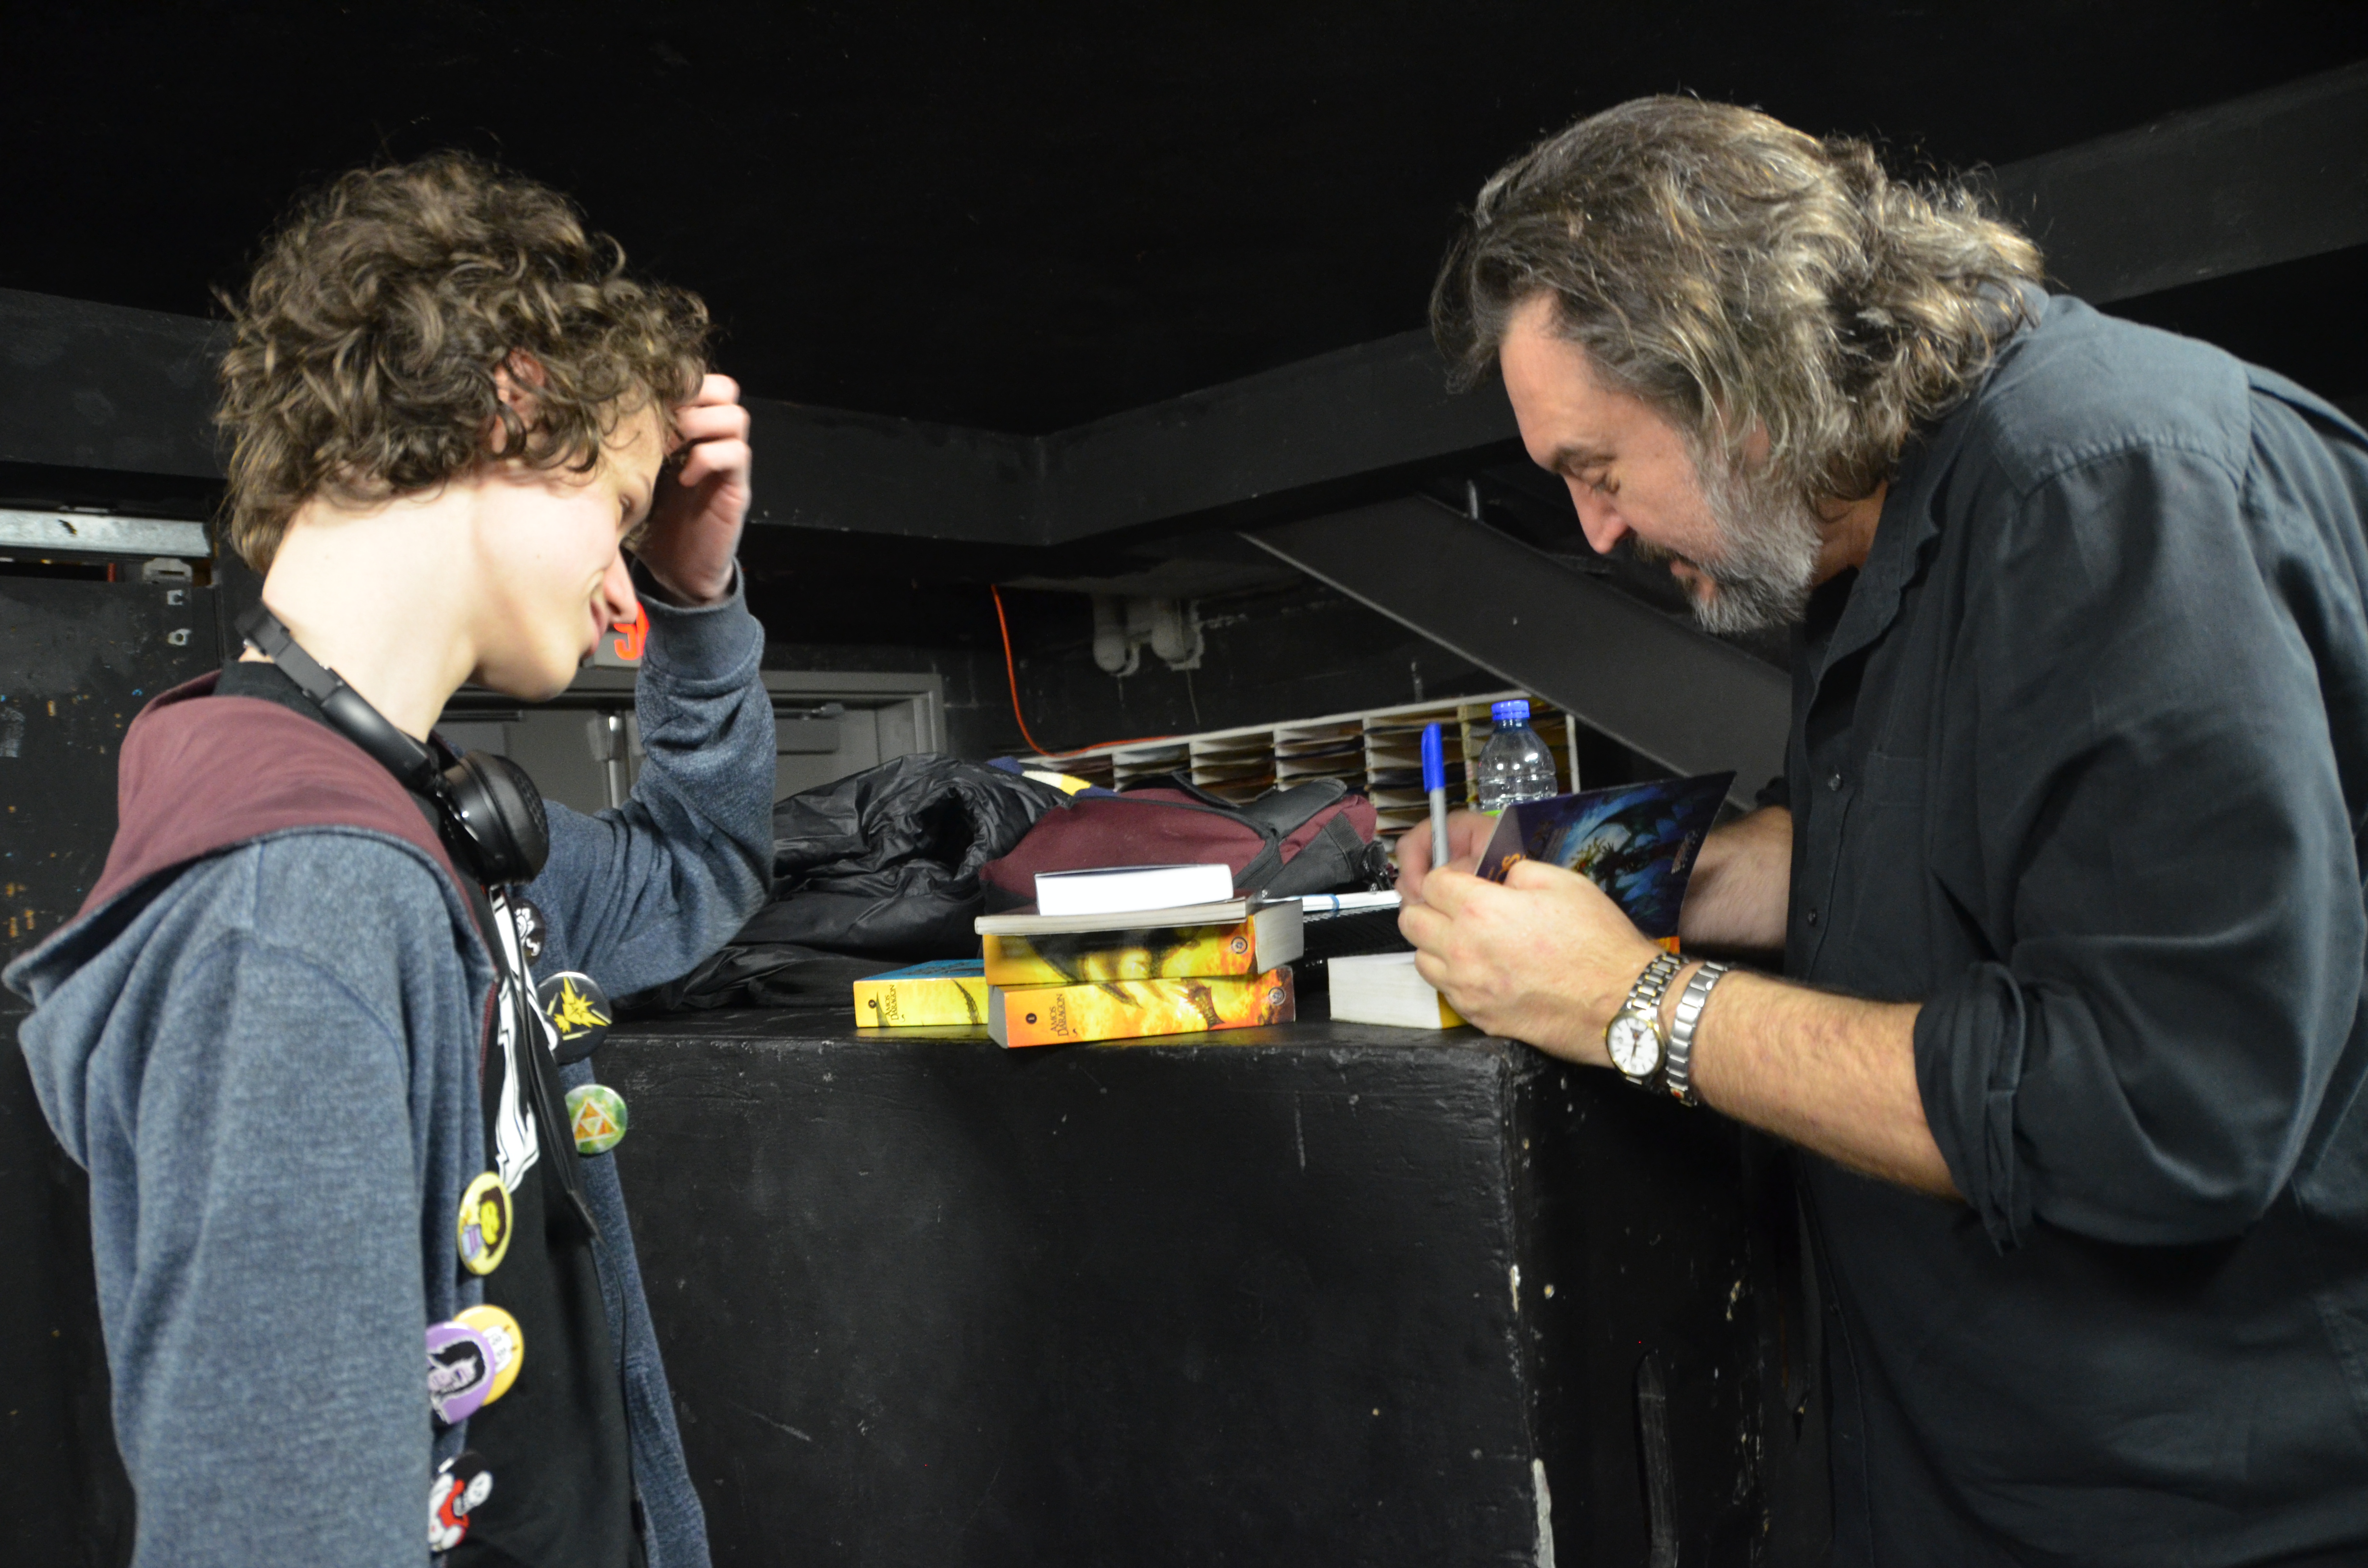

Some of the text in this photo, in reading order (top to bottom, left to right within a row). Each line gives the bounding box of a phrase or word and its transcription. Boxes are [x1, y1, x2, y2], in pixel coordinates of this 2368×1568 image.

[890, 985, 899, 1020] DARAGON
[1049, 1006, 1059, 1031] AMOS
[1056, 993, 1069, 1036] DARAGON
